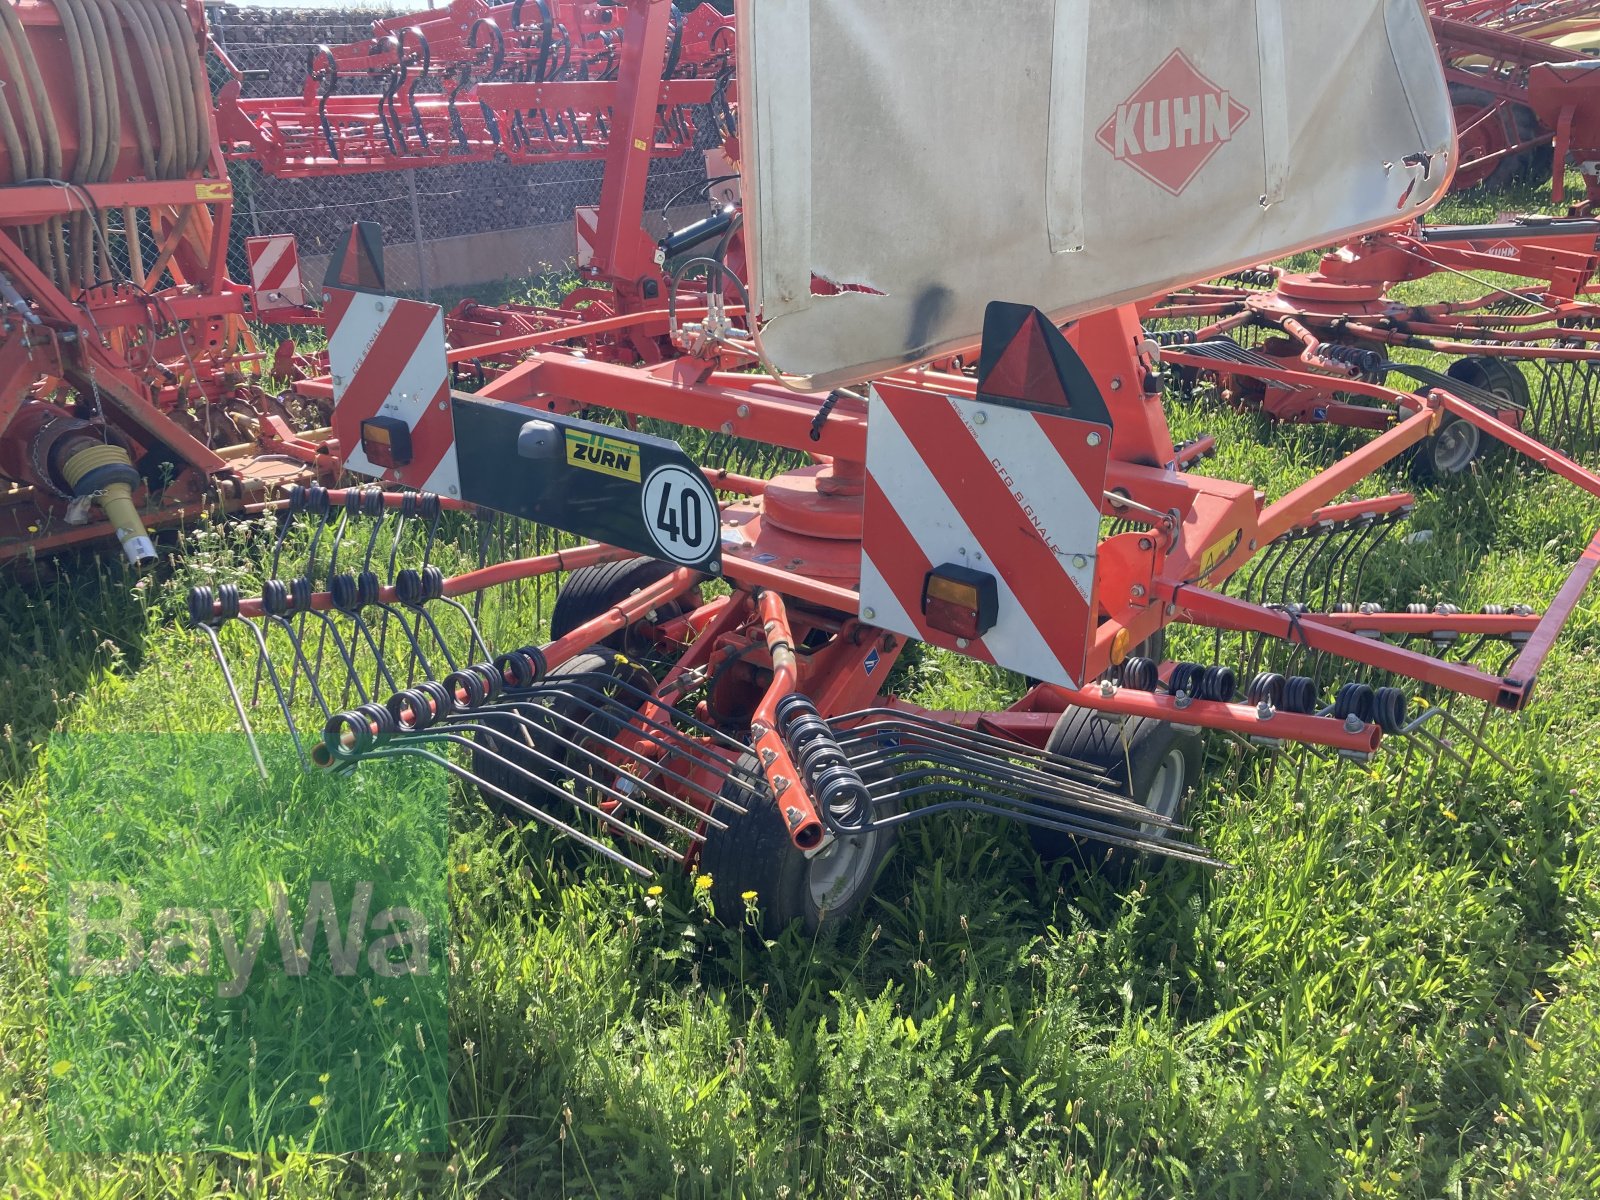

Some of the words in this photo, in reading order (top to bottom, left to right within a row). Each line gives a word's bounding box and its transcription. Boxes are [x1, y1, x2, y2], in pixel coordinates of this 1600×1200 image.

[1115, 91, 1231, 159] KUHN
[1488, 247, 1515, 257] KUHN
[991, 458, 1014, 488] CFG
[657, 481, 702, 548] 40
